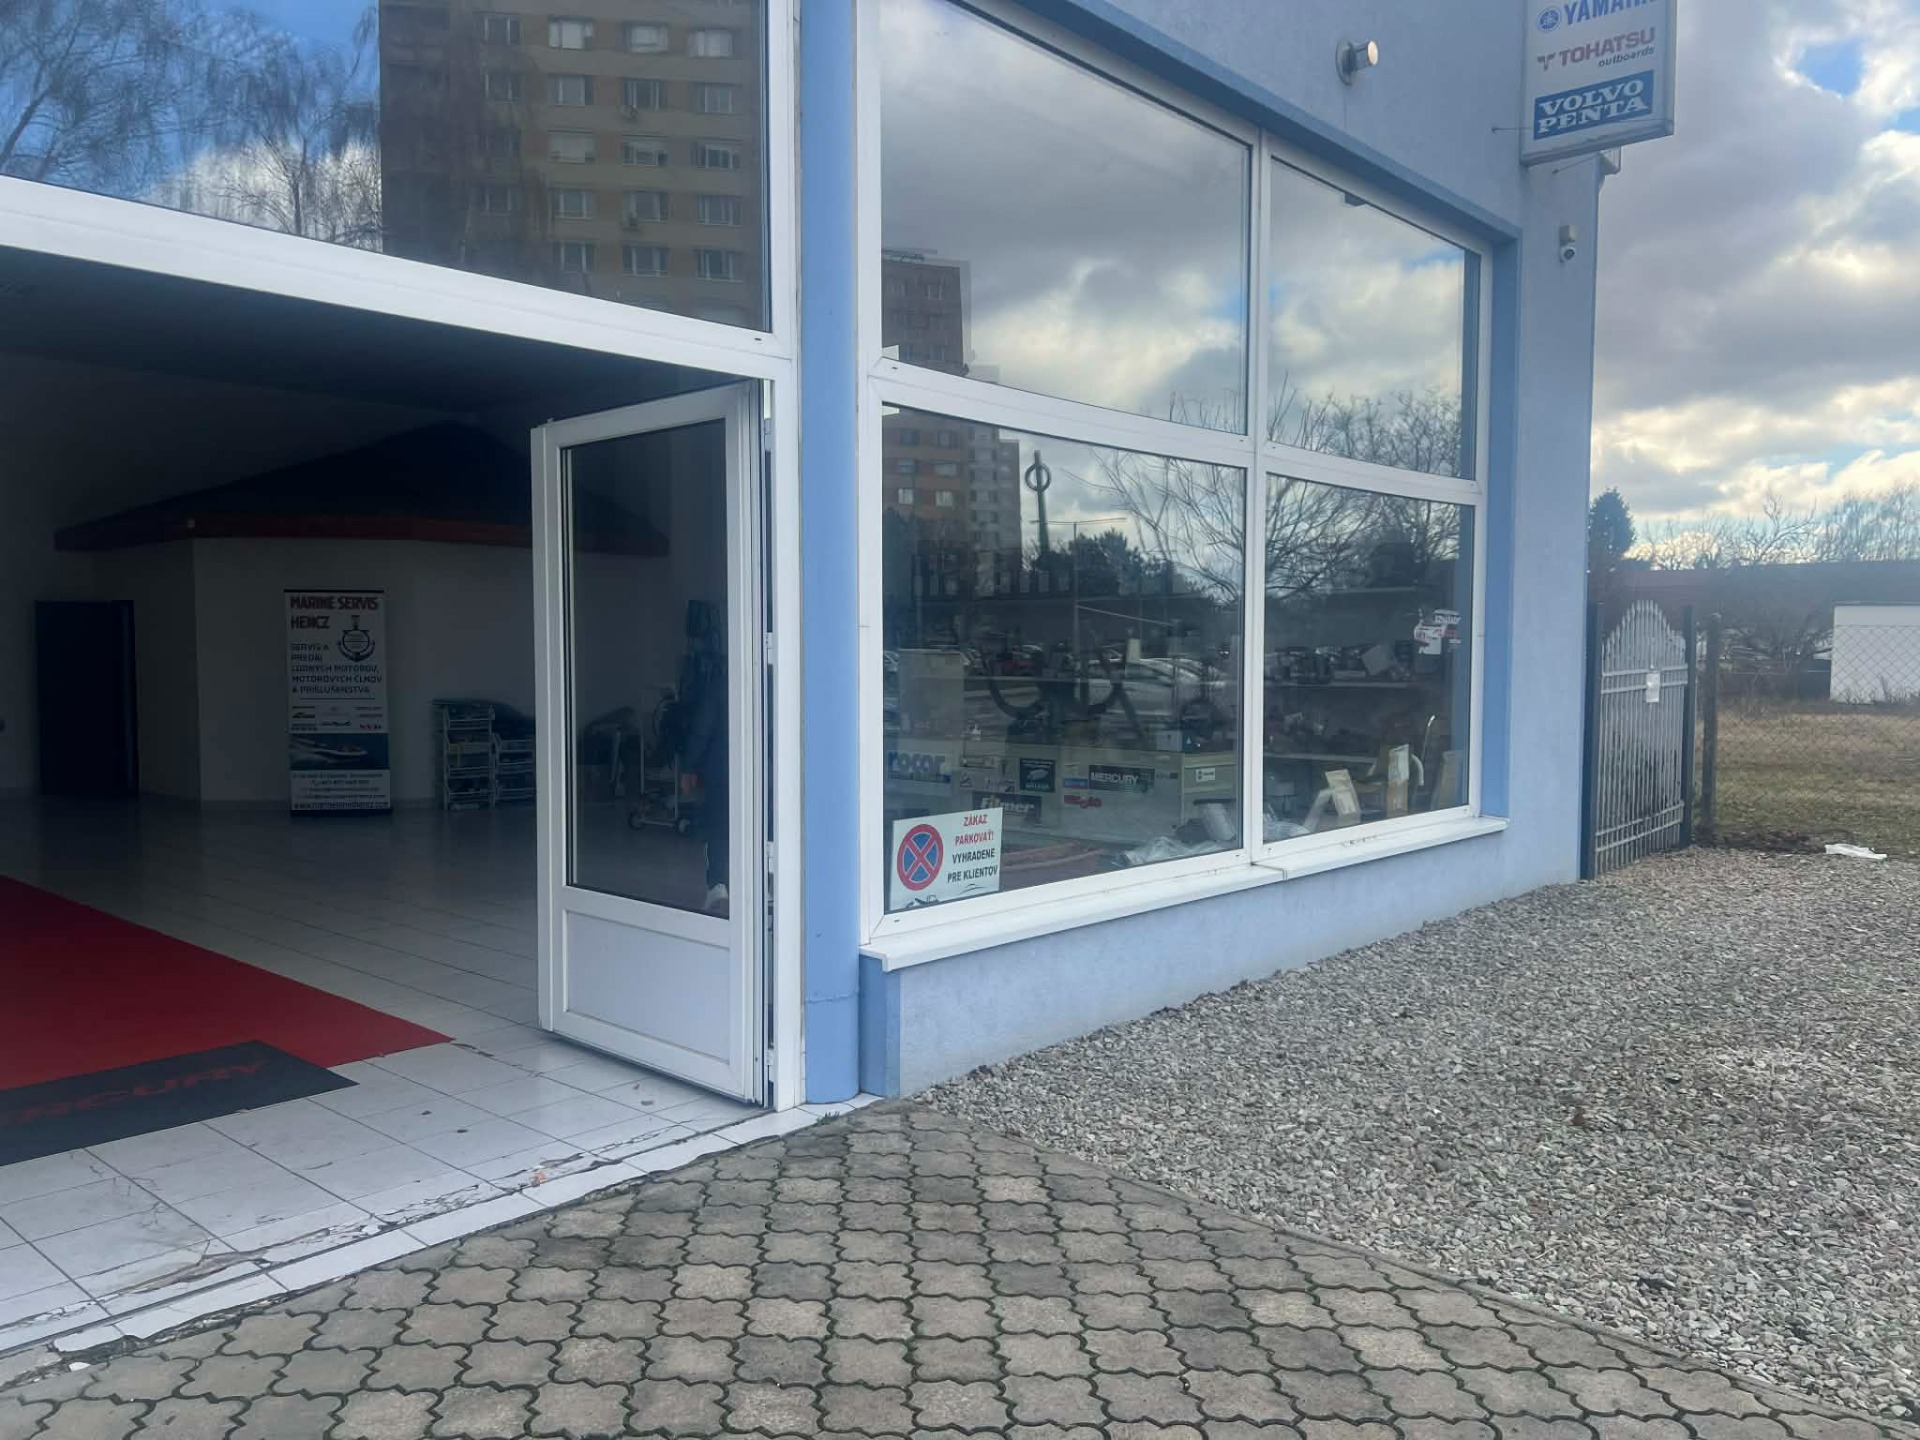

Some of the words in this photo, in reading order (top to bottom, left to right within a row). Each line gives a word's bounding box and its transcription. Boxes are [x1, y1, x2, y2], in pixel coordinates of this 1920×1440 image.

[1564, 0, 1655, 25] YAMA
[1559, 27, 1656, 66] TOHATSU
[1598, 45, 1655, 67] outboards
[1539, 79, 1644, 116] VOLVO
[1538, 96, 1648, 133] PENTA
[290, 597, 336, 609] MARINE
[337, 597, 378, 610] SERVIS
[1090, 772, 1139, 786] MERCURY
[963, 813, 988, 827] ZÁKAZ
[947, 870, 962, 884] PRE
